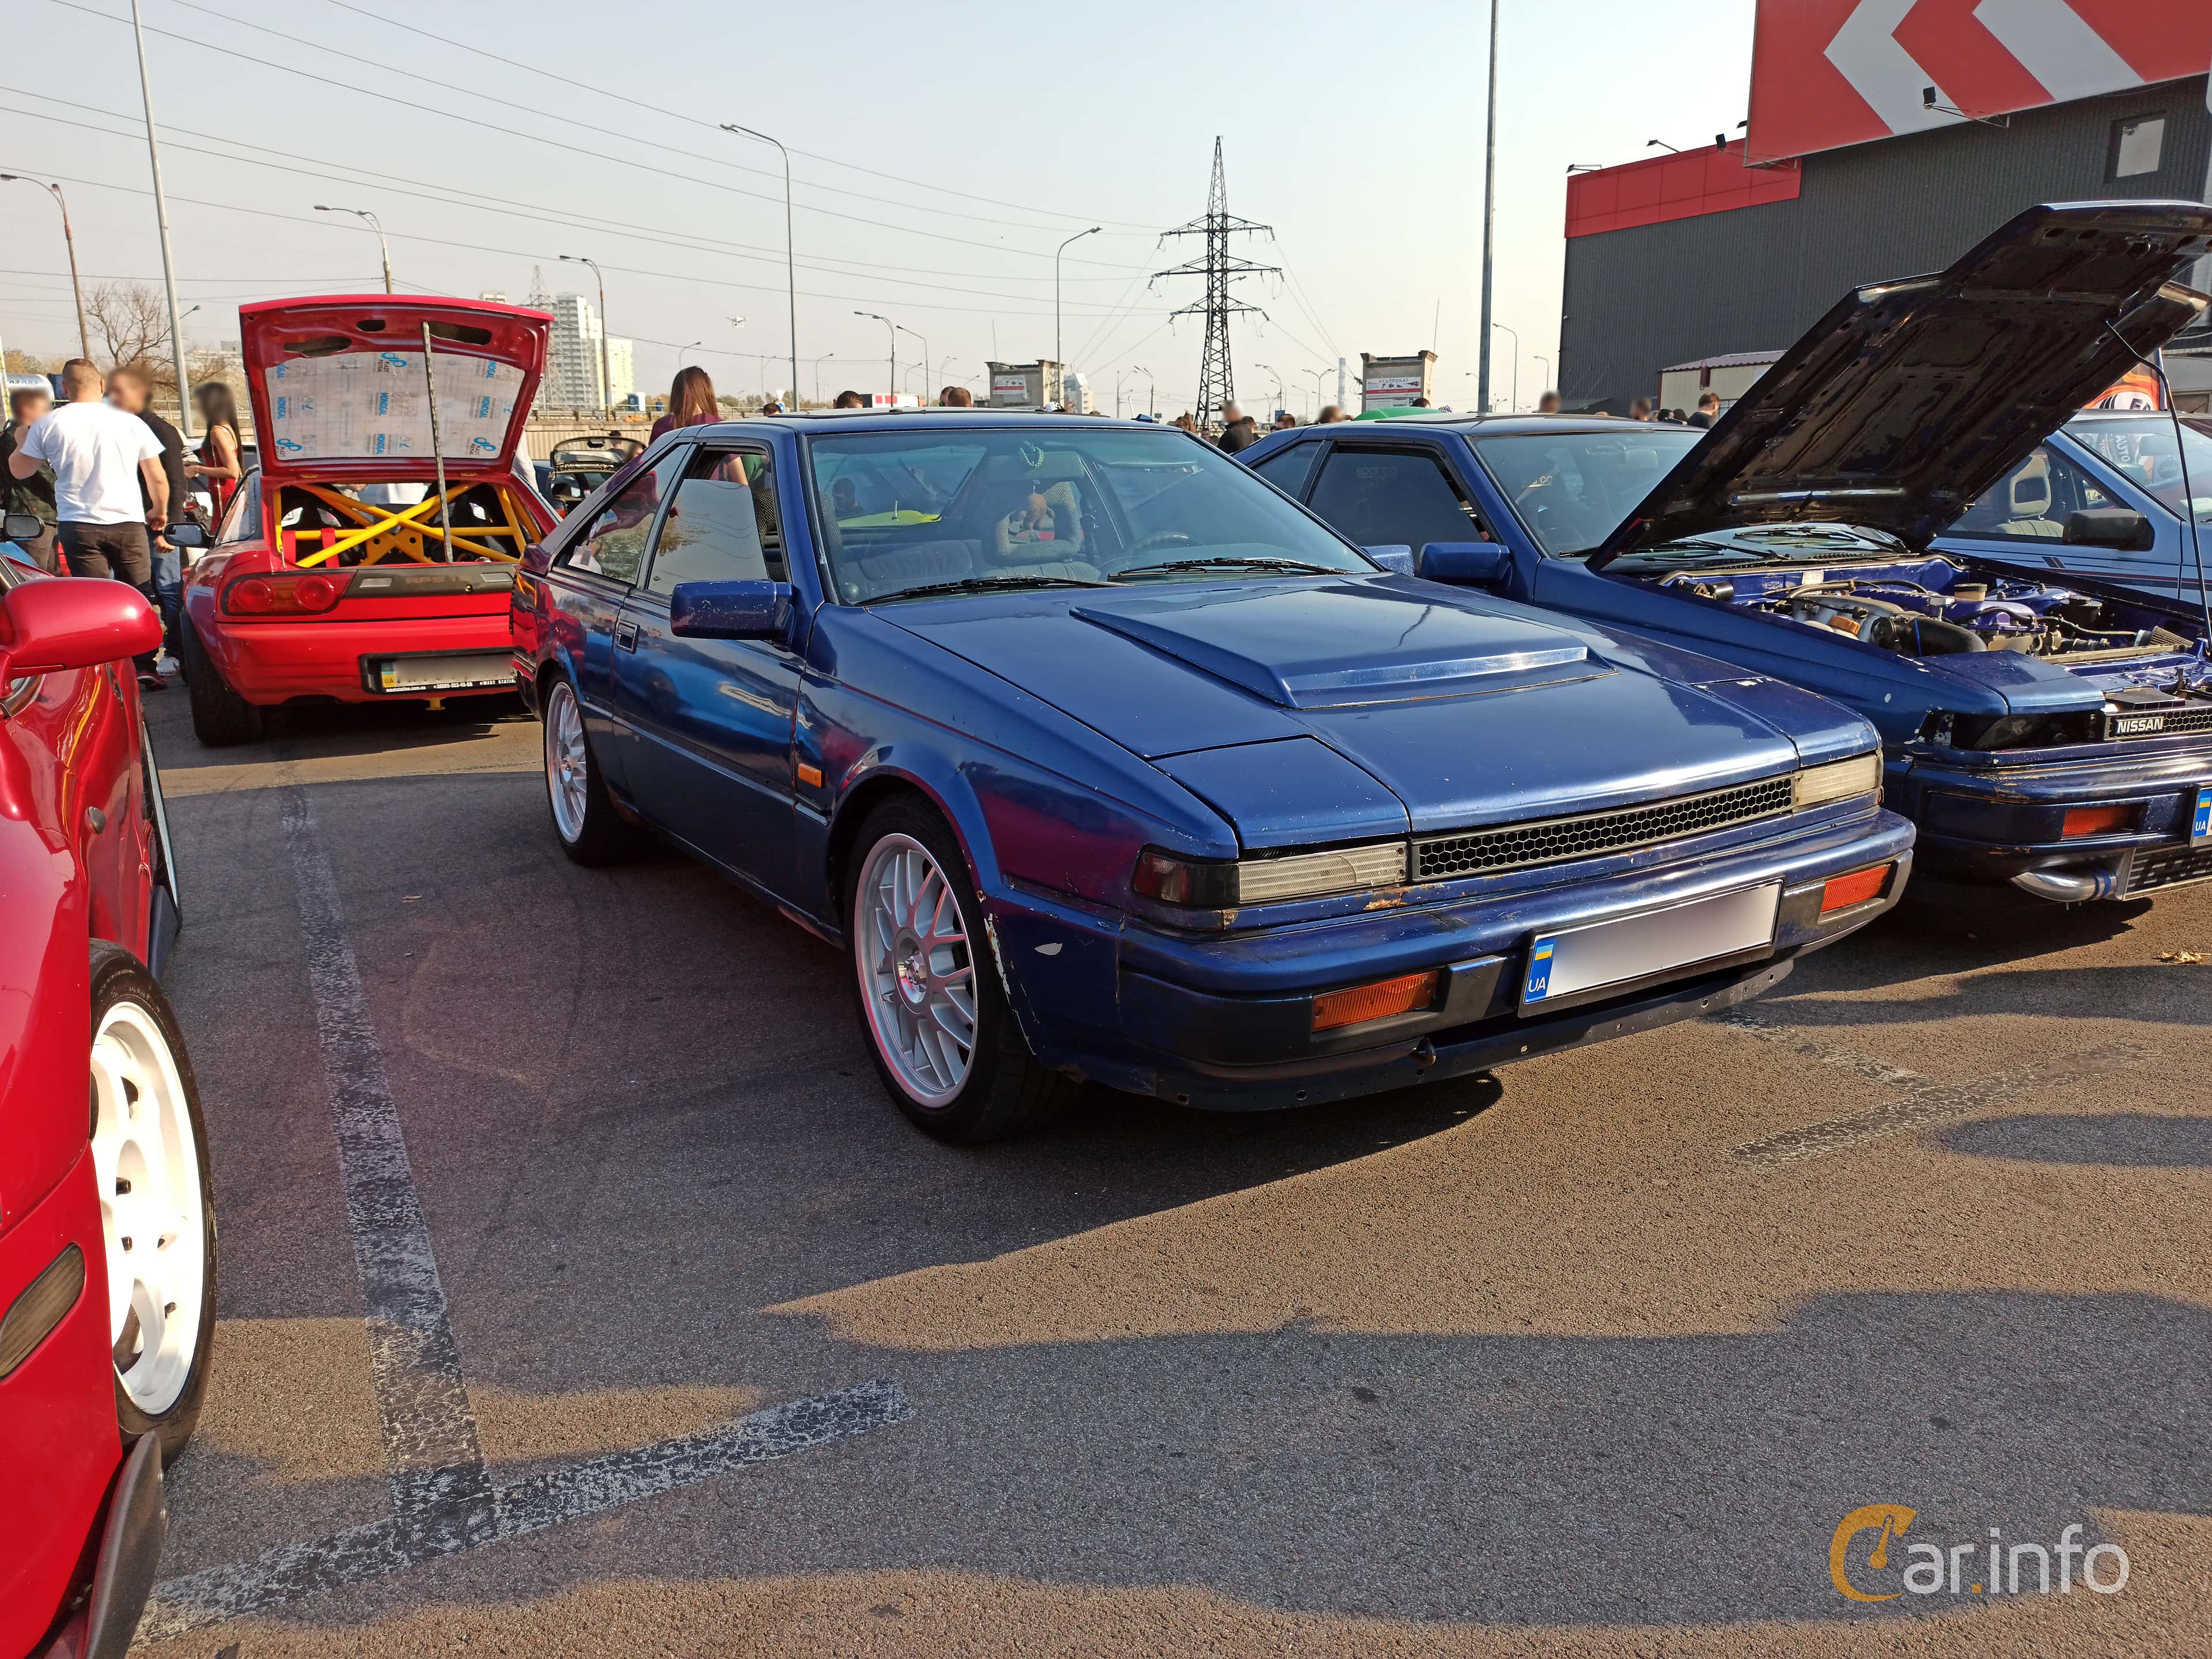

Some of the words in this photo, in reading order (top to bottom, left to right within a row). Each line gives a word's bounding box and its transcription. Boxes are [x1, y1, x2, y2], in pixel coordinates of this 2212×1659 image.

[277, 396, 286, 419] MONOGAL
[379, 392, 388, 415] MONOGAL
[479, 396, 490, 418] MONOGAL
[377, 433, 385, 455] MONOGAL
[2115, 435, 2130, 461] AUTO
[2117, 718, 2164, 733] NISSAN
[2195, 820, 2206, 831] UA
[1528, 976, 1546, 993] UA
